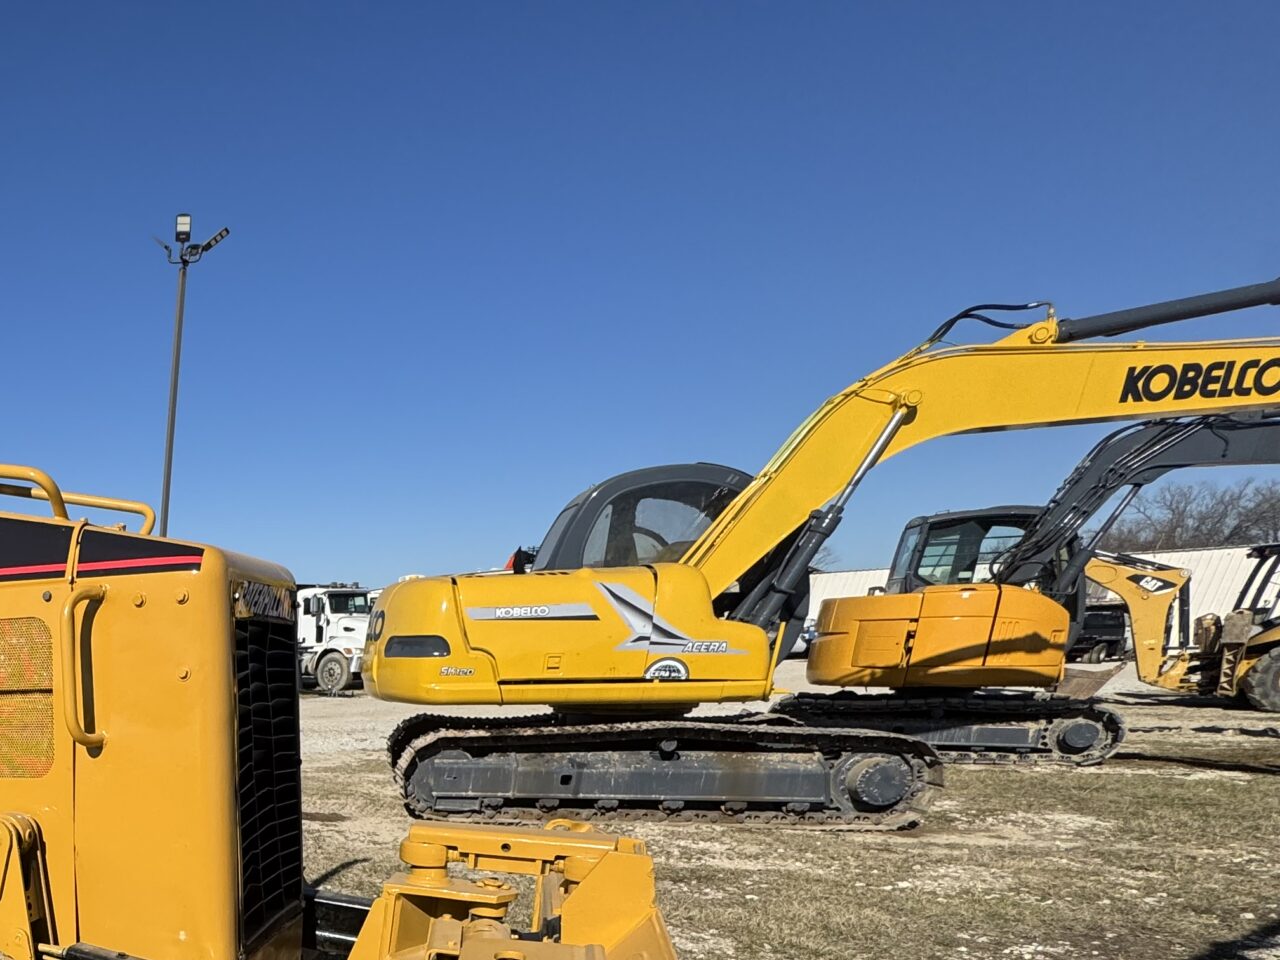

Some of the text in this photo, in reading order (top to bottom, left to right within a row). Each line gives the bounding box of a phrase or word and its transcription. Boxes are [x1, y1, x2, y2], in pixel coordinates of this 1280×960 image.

[1118, 357, 1280, 403] KOBELCO
[1139, 576, 1164, 591] CAT
[495, 605, 550, 618] KOBELCO
[682, 641, 727, 653] ACERA
